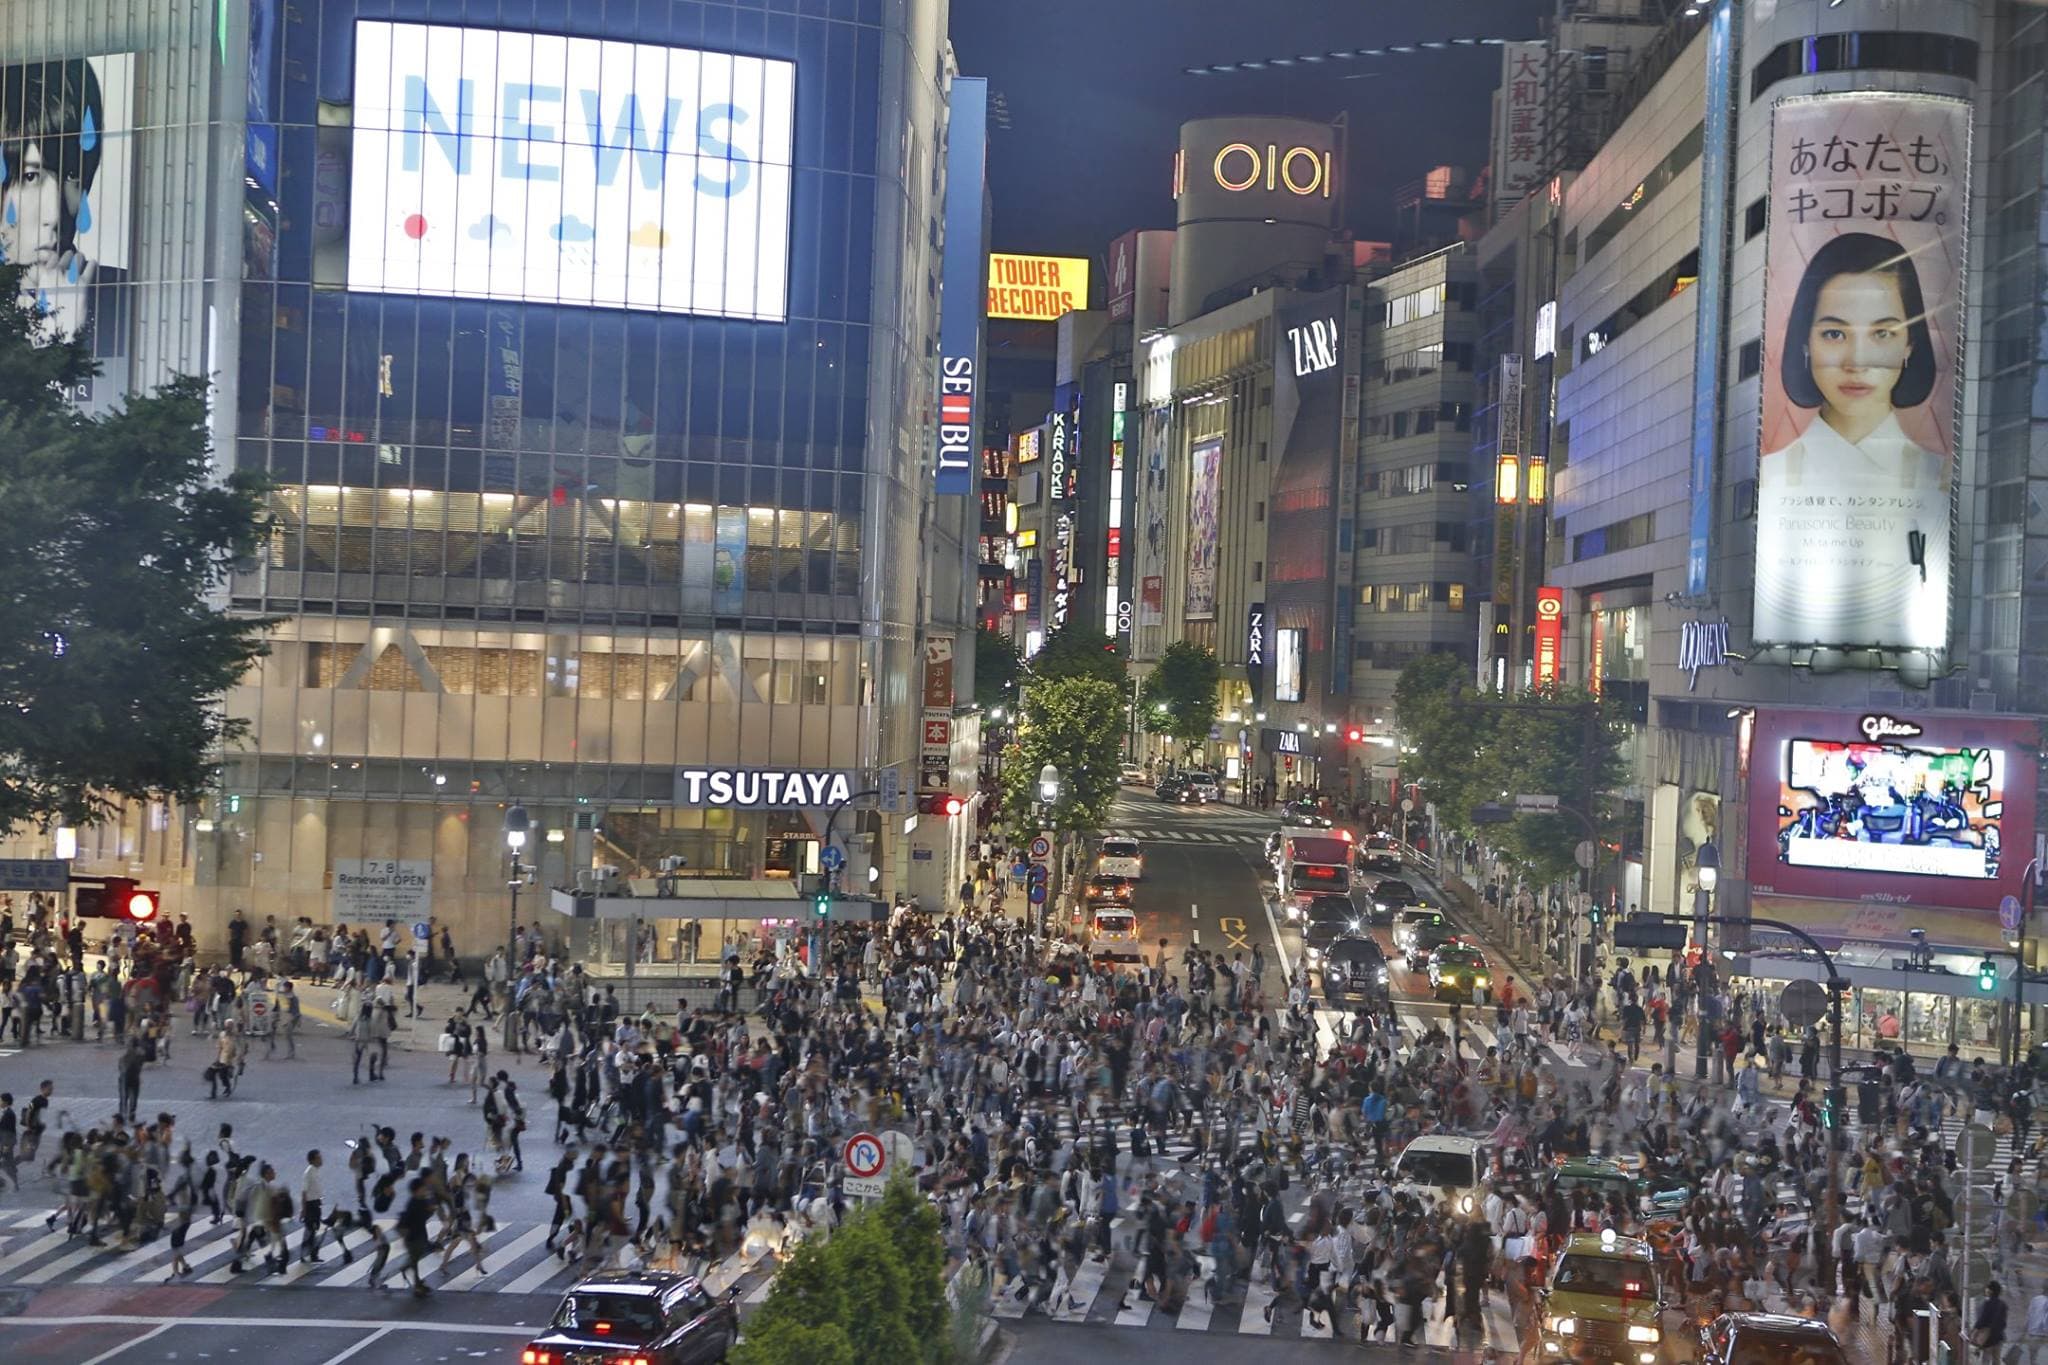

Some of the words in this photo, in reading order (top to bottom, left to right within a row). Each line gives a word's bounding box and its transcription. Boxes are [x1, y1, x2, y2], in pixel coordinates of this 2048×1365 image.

[1511, 53, 1539, 162] 大和証券
[401, 74, 751, 199] NEWS
[994, 258, 1061, 288] TOWER
[988, 287, 1074, 316] RECORDS
[940, 357, 972, 470] SEIBU
[1051, 413, 1065, 499] KARAOKE
[1778, 517, 1841, 531] Panasonic
[1845, 516, 1896, 533] Beauty
[1249, 613, 1262, 664] ZARA
[928, 723, 945, 741] 本
[1279, 732, 1299, 752] ZARA
[1863, 717, 1920, 741] Glico
[684, 770, 850, 805] TSUTAYA
[339, 873, 389, 885] Renewal
[393, 875, 426, 886] OPEN
[846, 1181, 882, 1194] ここから
